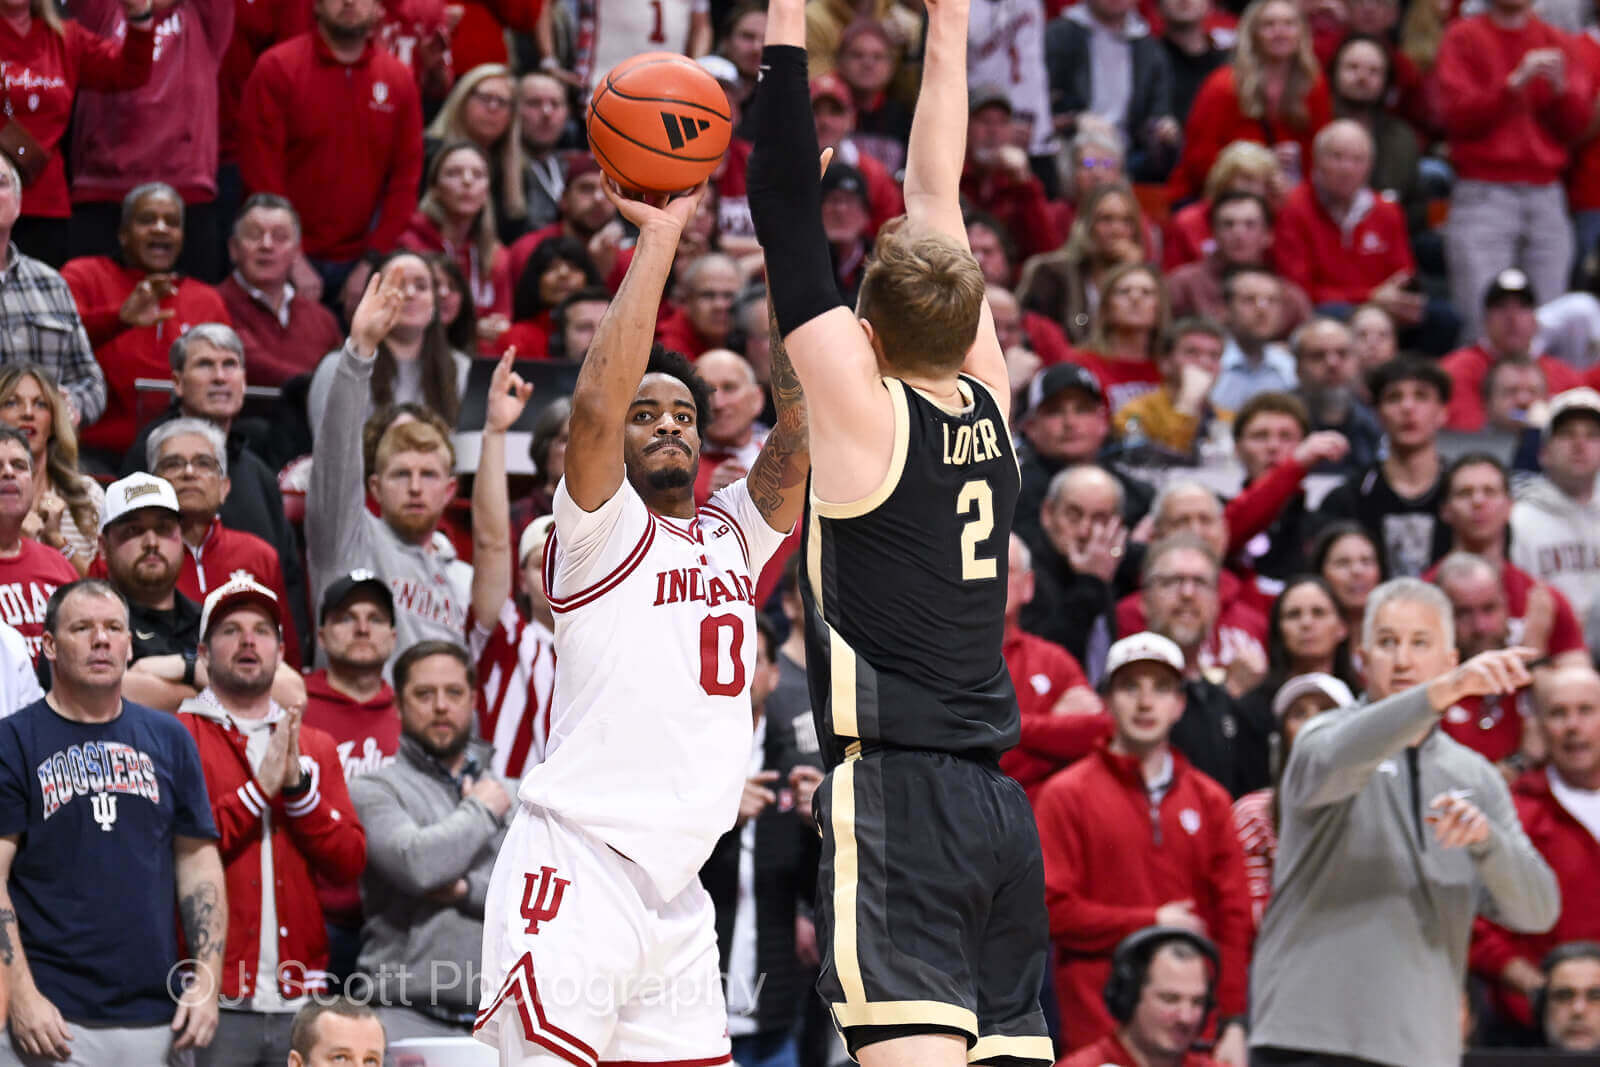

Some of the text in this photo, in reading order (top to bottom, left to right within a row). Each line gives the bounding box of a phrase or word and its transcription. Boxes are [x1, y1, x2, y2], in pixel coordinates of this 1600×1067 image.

[943, 418, 1003, 465] LOER
[956, 479, 998, 581] 2
[653, 567, 756, 608] INDAN
[699, 613, 746, 697] 0
[37, 741, 160, 821] HOOSIERS
[520, 865, 571, 935] IU
